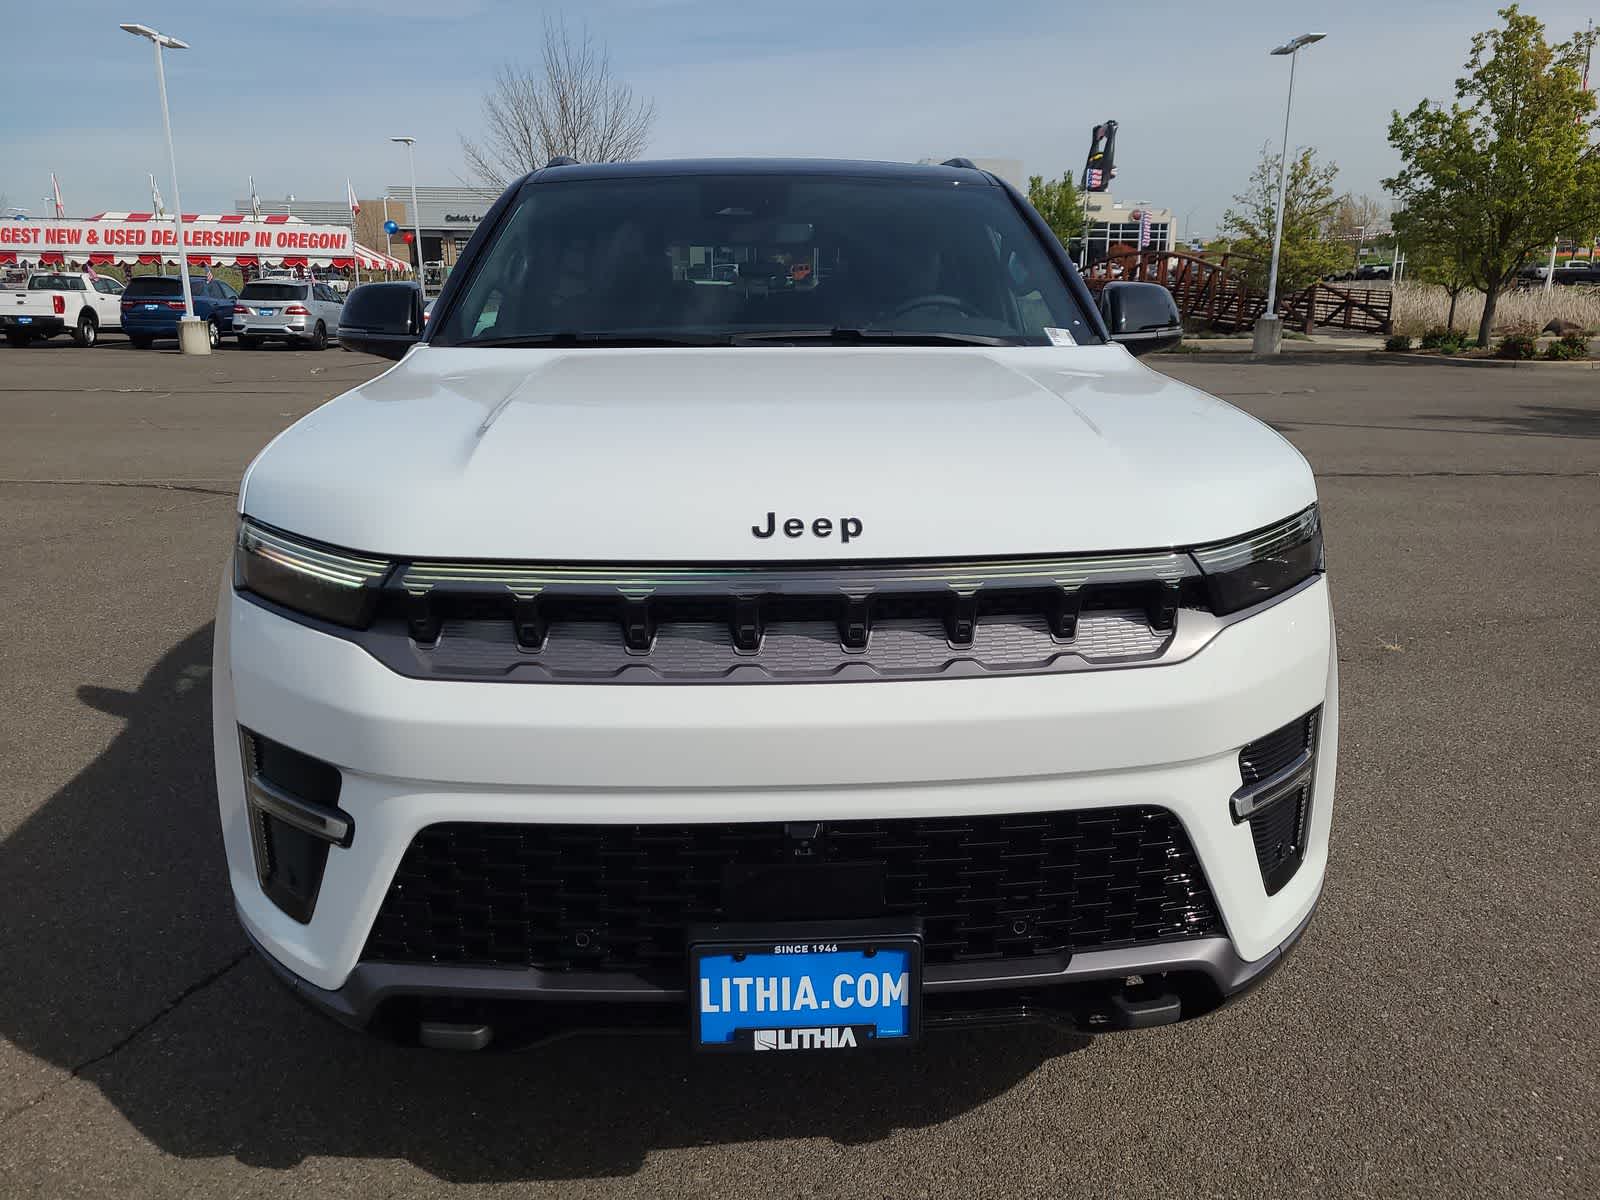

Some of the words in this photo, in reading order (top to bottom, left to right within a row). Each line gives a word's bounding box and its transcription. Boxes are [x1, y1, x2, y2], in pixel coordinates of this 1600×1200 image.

[0, 227, 41, 244] GEST
[45, 228, 82, 245] NEW
[86, 229, 99, 245] &
[104, 229, 146, 246] USED
[254, 231, 271, 248] IN
[276, 231, 348, 249] OREGON!
[751, 512, 863, 543] Jeep
[774, 945, 809, 954] SINCE
[812, 944, 838, 953] 1946
[700, 972, 909, 1013] LITHIA.COM
[778, 1027, 857, 1050] LITHIA
